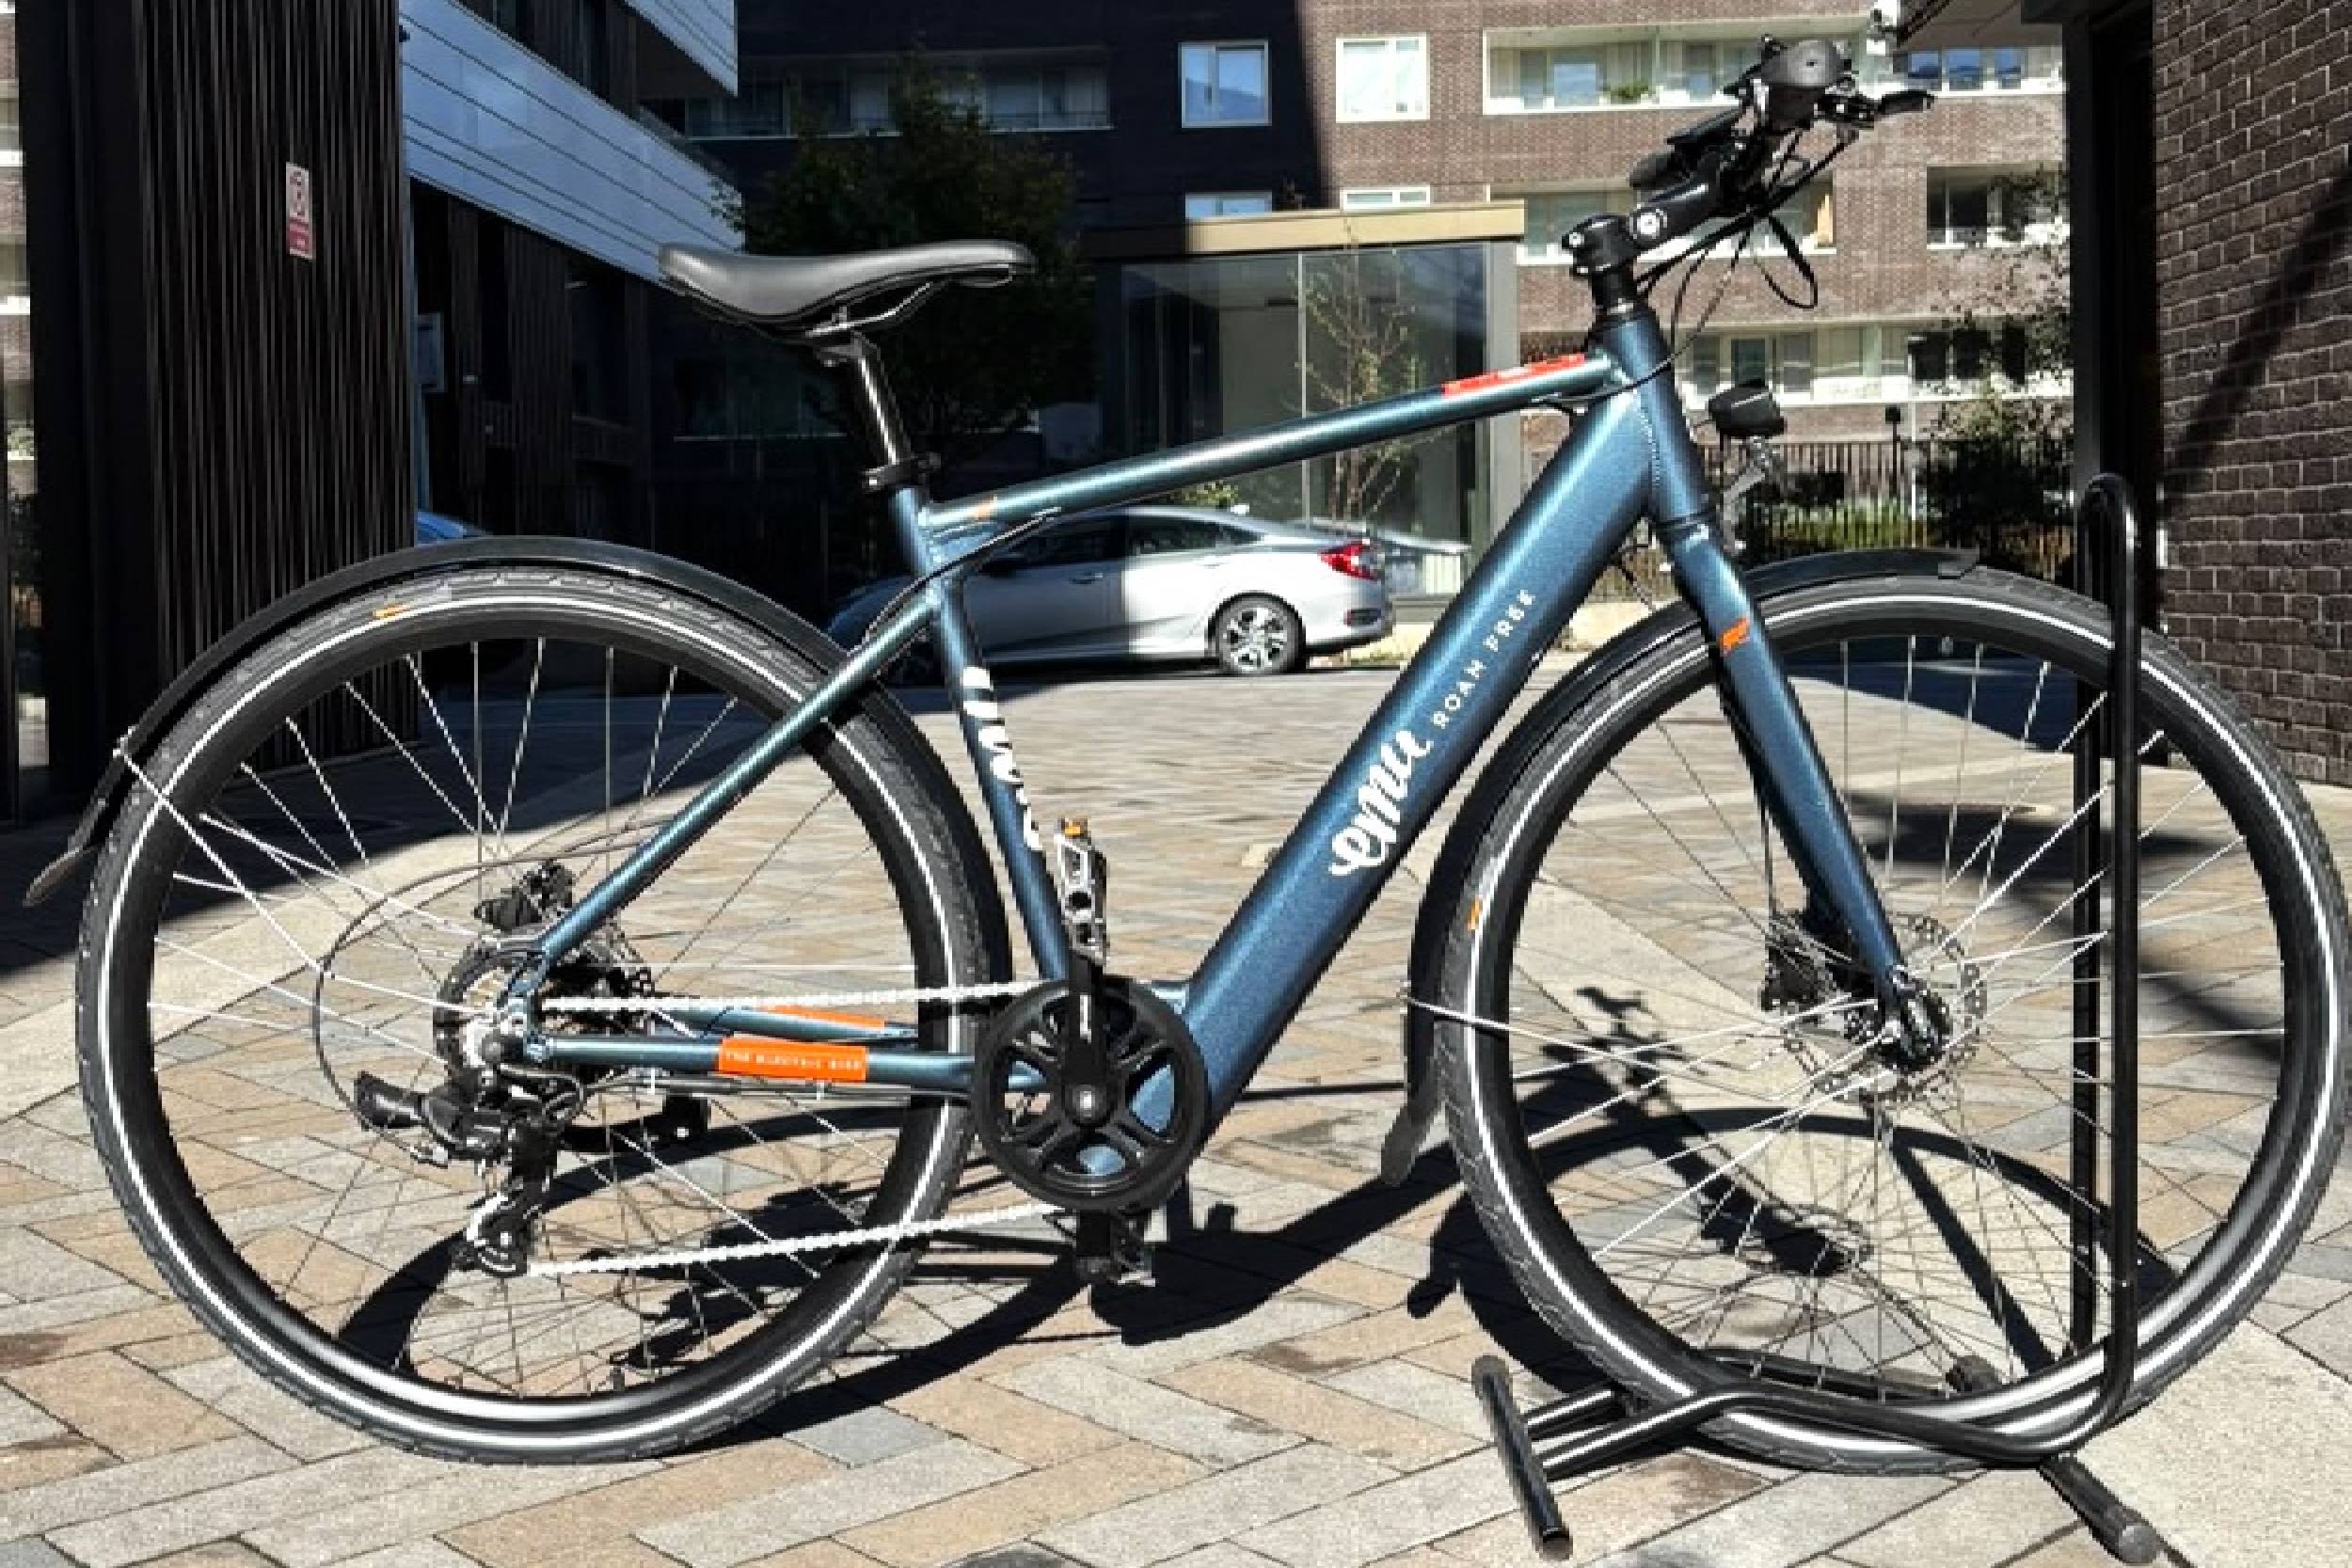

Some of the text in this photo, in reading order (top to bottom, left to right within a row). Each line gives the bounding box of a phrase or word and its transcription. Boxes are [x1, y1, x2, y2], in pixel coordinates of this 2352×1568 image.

[1429, 588, 1537, 731] ROAM FREE
[1327, 729, 1435, 877] emu
